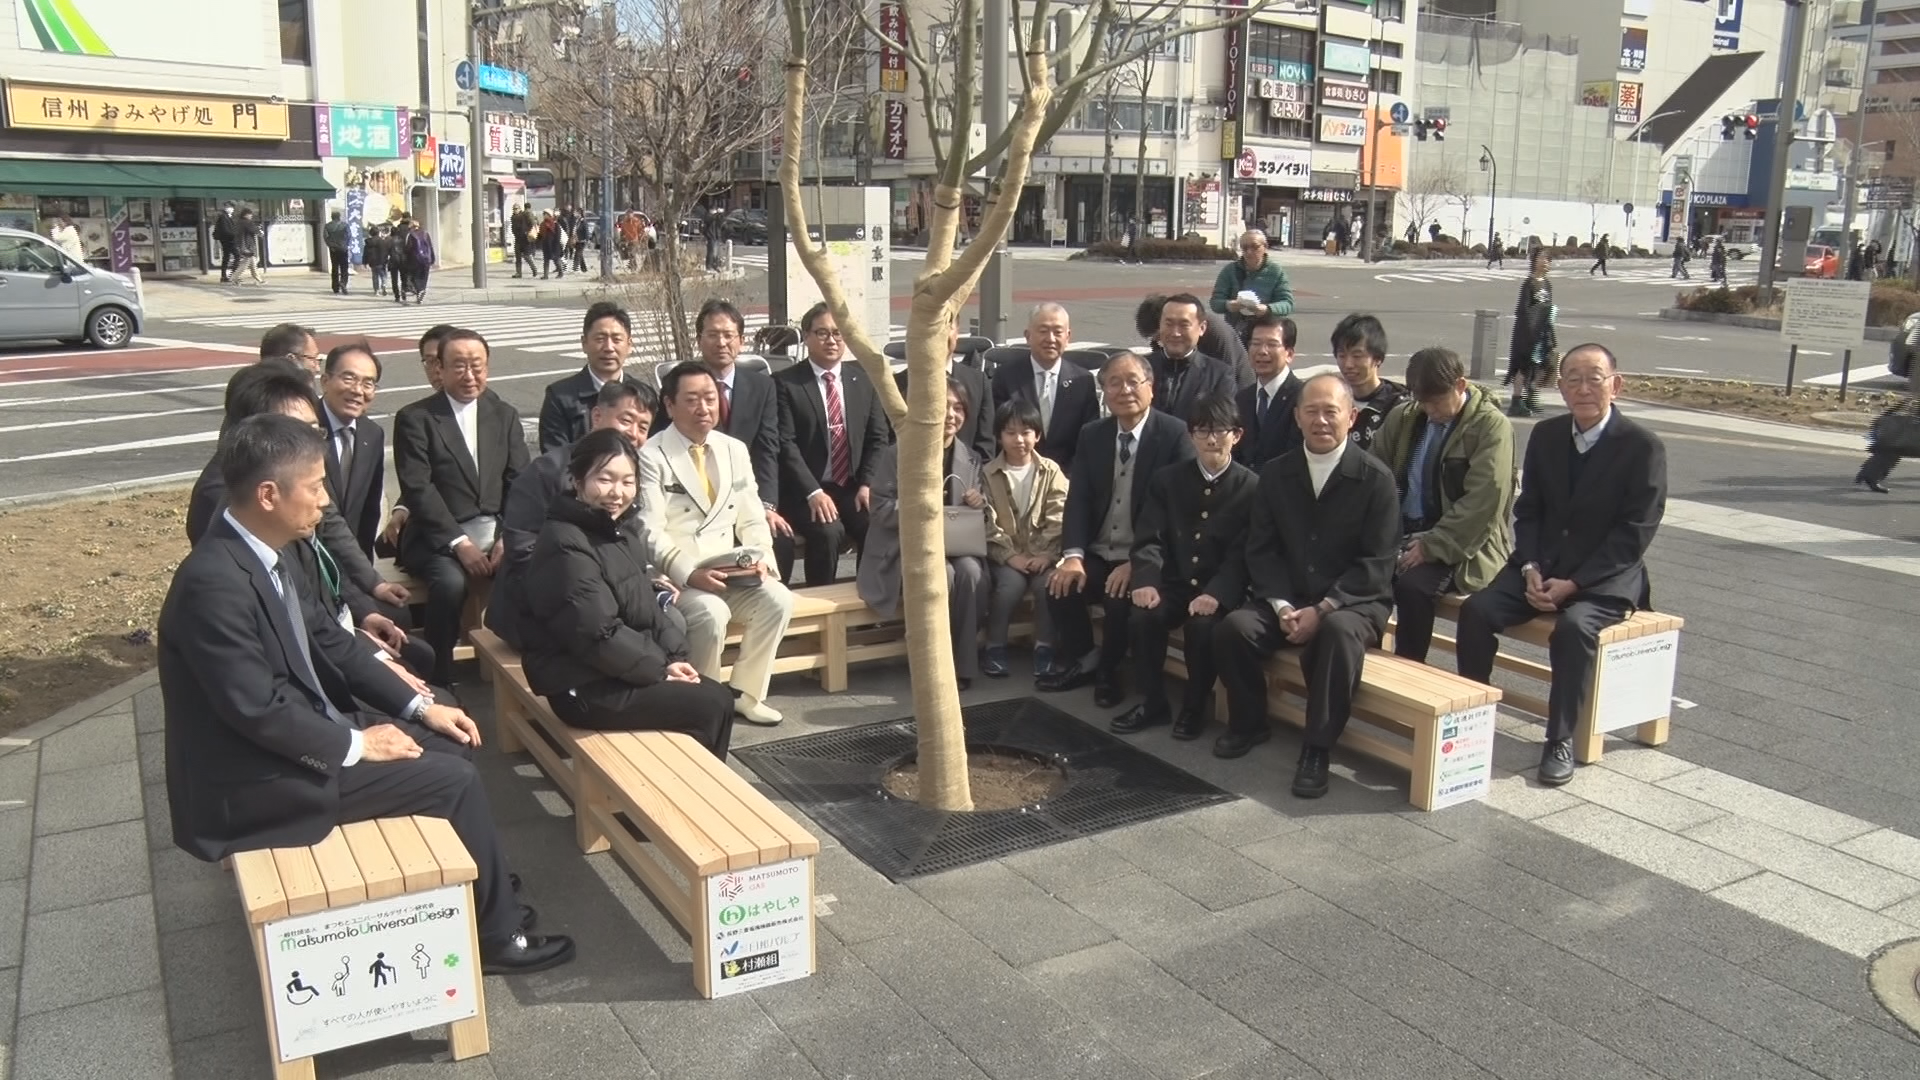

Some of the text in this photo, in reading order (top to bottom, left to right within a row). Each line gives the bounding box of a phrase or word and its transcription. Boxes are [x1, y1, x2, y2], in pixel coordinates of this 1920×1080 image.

[1280, 63, 1307, 80] NOVA
[1262, 81, 1296, 100] 食事処
[1345, 88, 1366, 102] むさし
[1620, 84, 1637, 107] 薬
[41, 97, 259, 130] 信州 おみやげ処 門
[337, 124, 391, 149] 地酒
[398, 117, 408, 145] ワイン
[488, 126, 501, 153] 質
[513, 129, 536, 155] 買取
[889, 101, 902, 158] カラオケ
[1707, 195, 1727, 205] PLAZA
[113, 229, 128, 268] ワイン
[748, 866, 799, 882] MATSUMOTO
[748, 896, 800, 917] はやしや
[742, 952, 778, 972] 村瀬組
